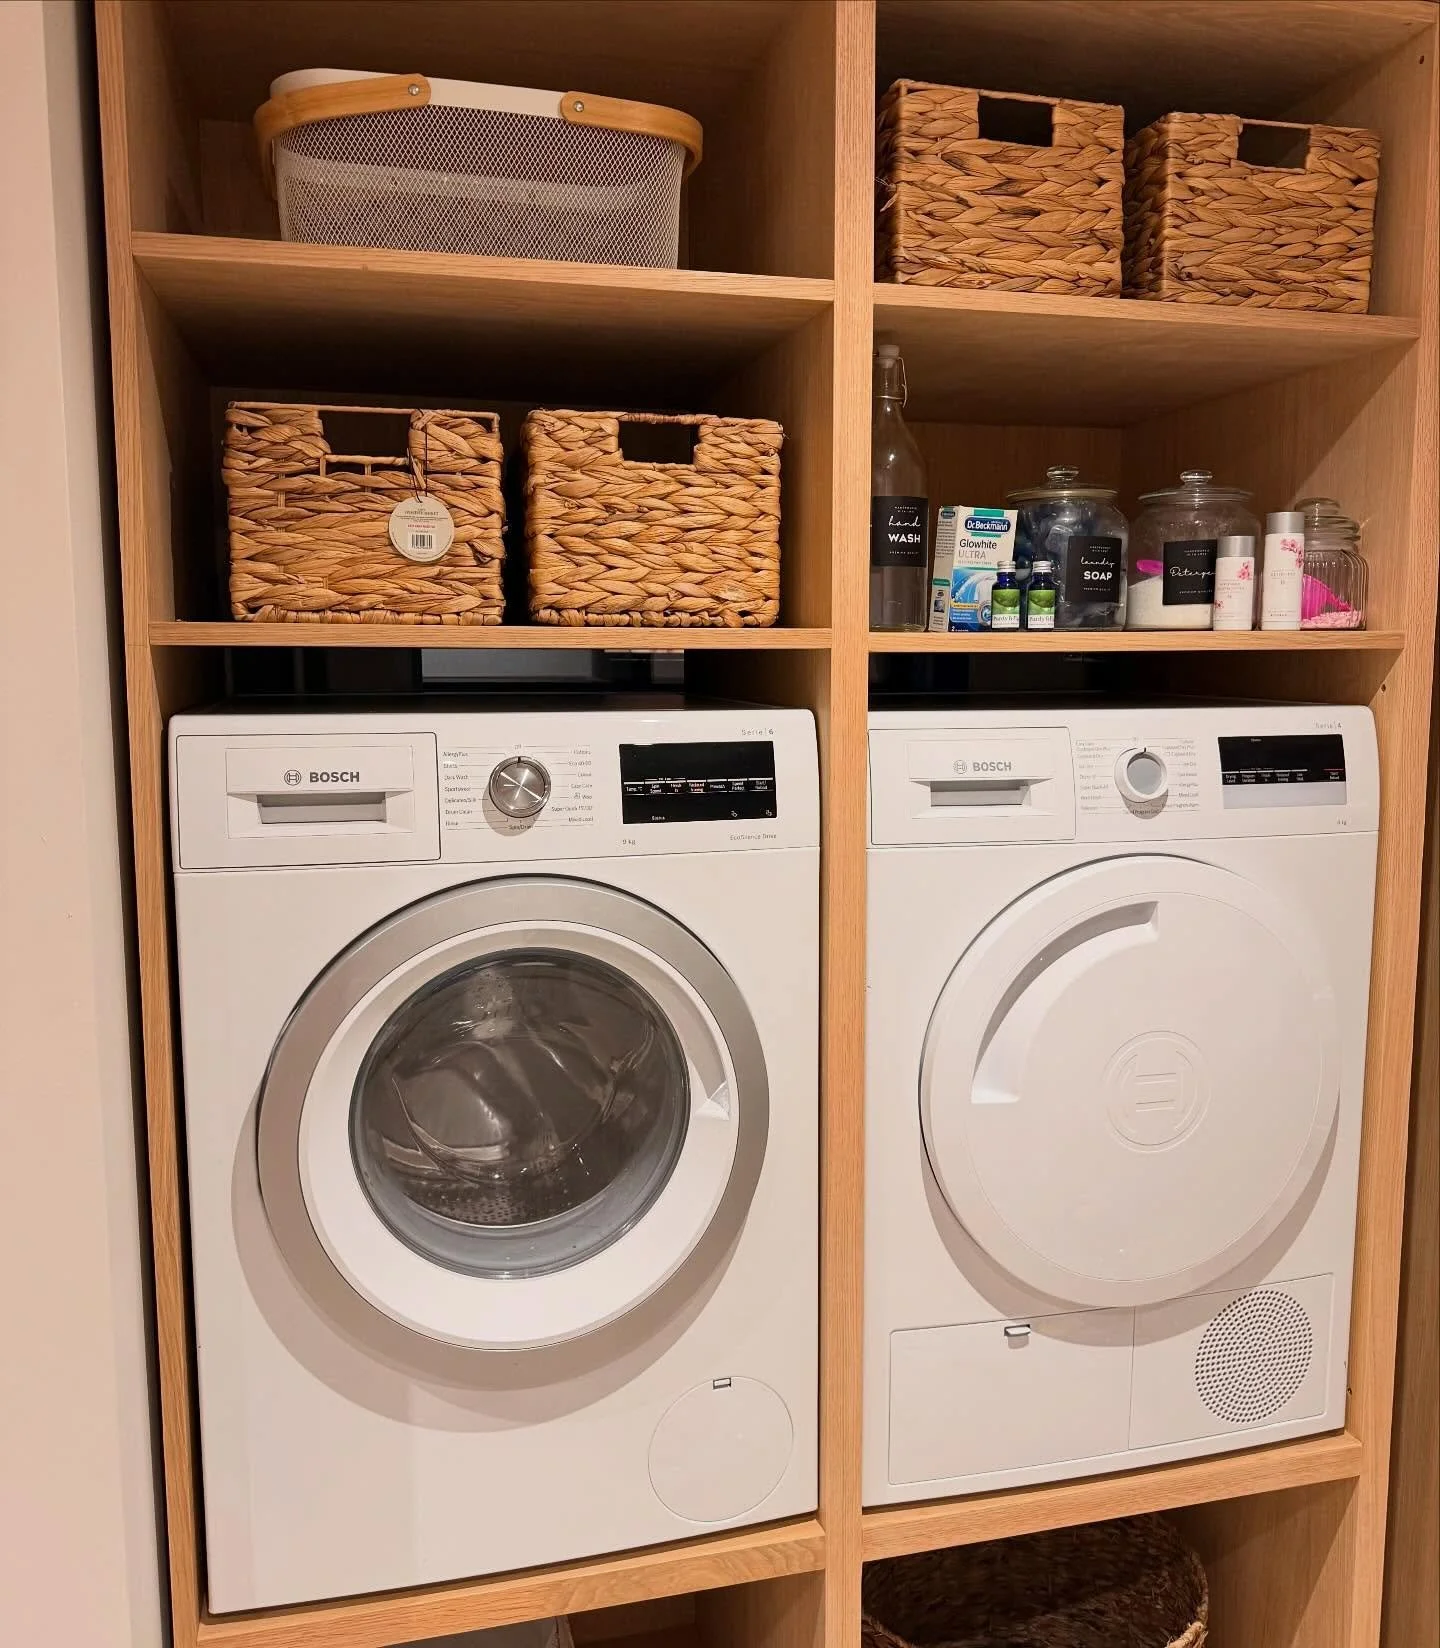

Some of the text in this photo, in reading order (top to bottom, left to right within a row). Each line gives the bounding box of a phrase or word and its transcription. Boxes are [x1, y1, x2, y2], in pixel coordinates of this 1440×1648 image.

[888, 516, 920, 526] hand
[888, 534, 920, 544] WASH
[960, 538, 998, 550] Glowhite
[958, 550, 986, 559] ULTRA
[1080, 556, 1116, 568] laundry
[1083, 570, 1113, 580] SOAP
[1169, 566, 1216, 579] Deterge
[972, 761, 1012, 772] BOSCH
[310, 771, 360, 783] BOSCH
